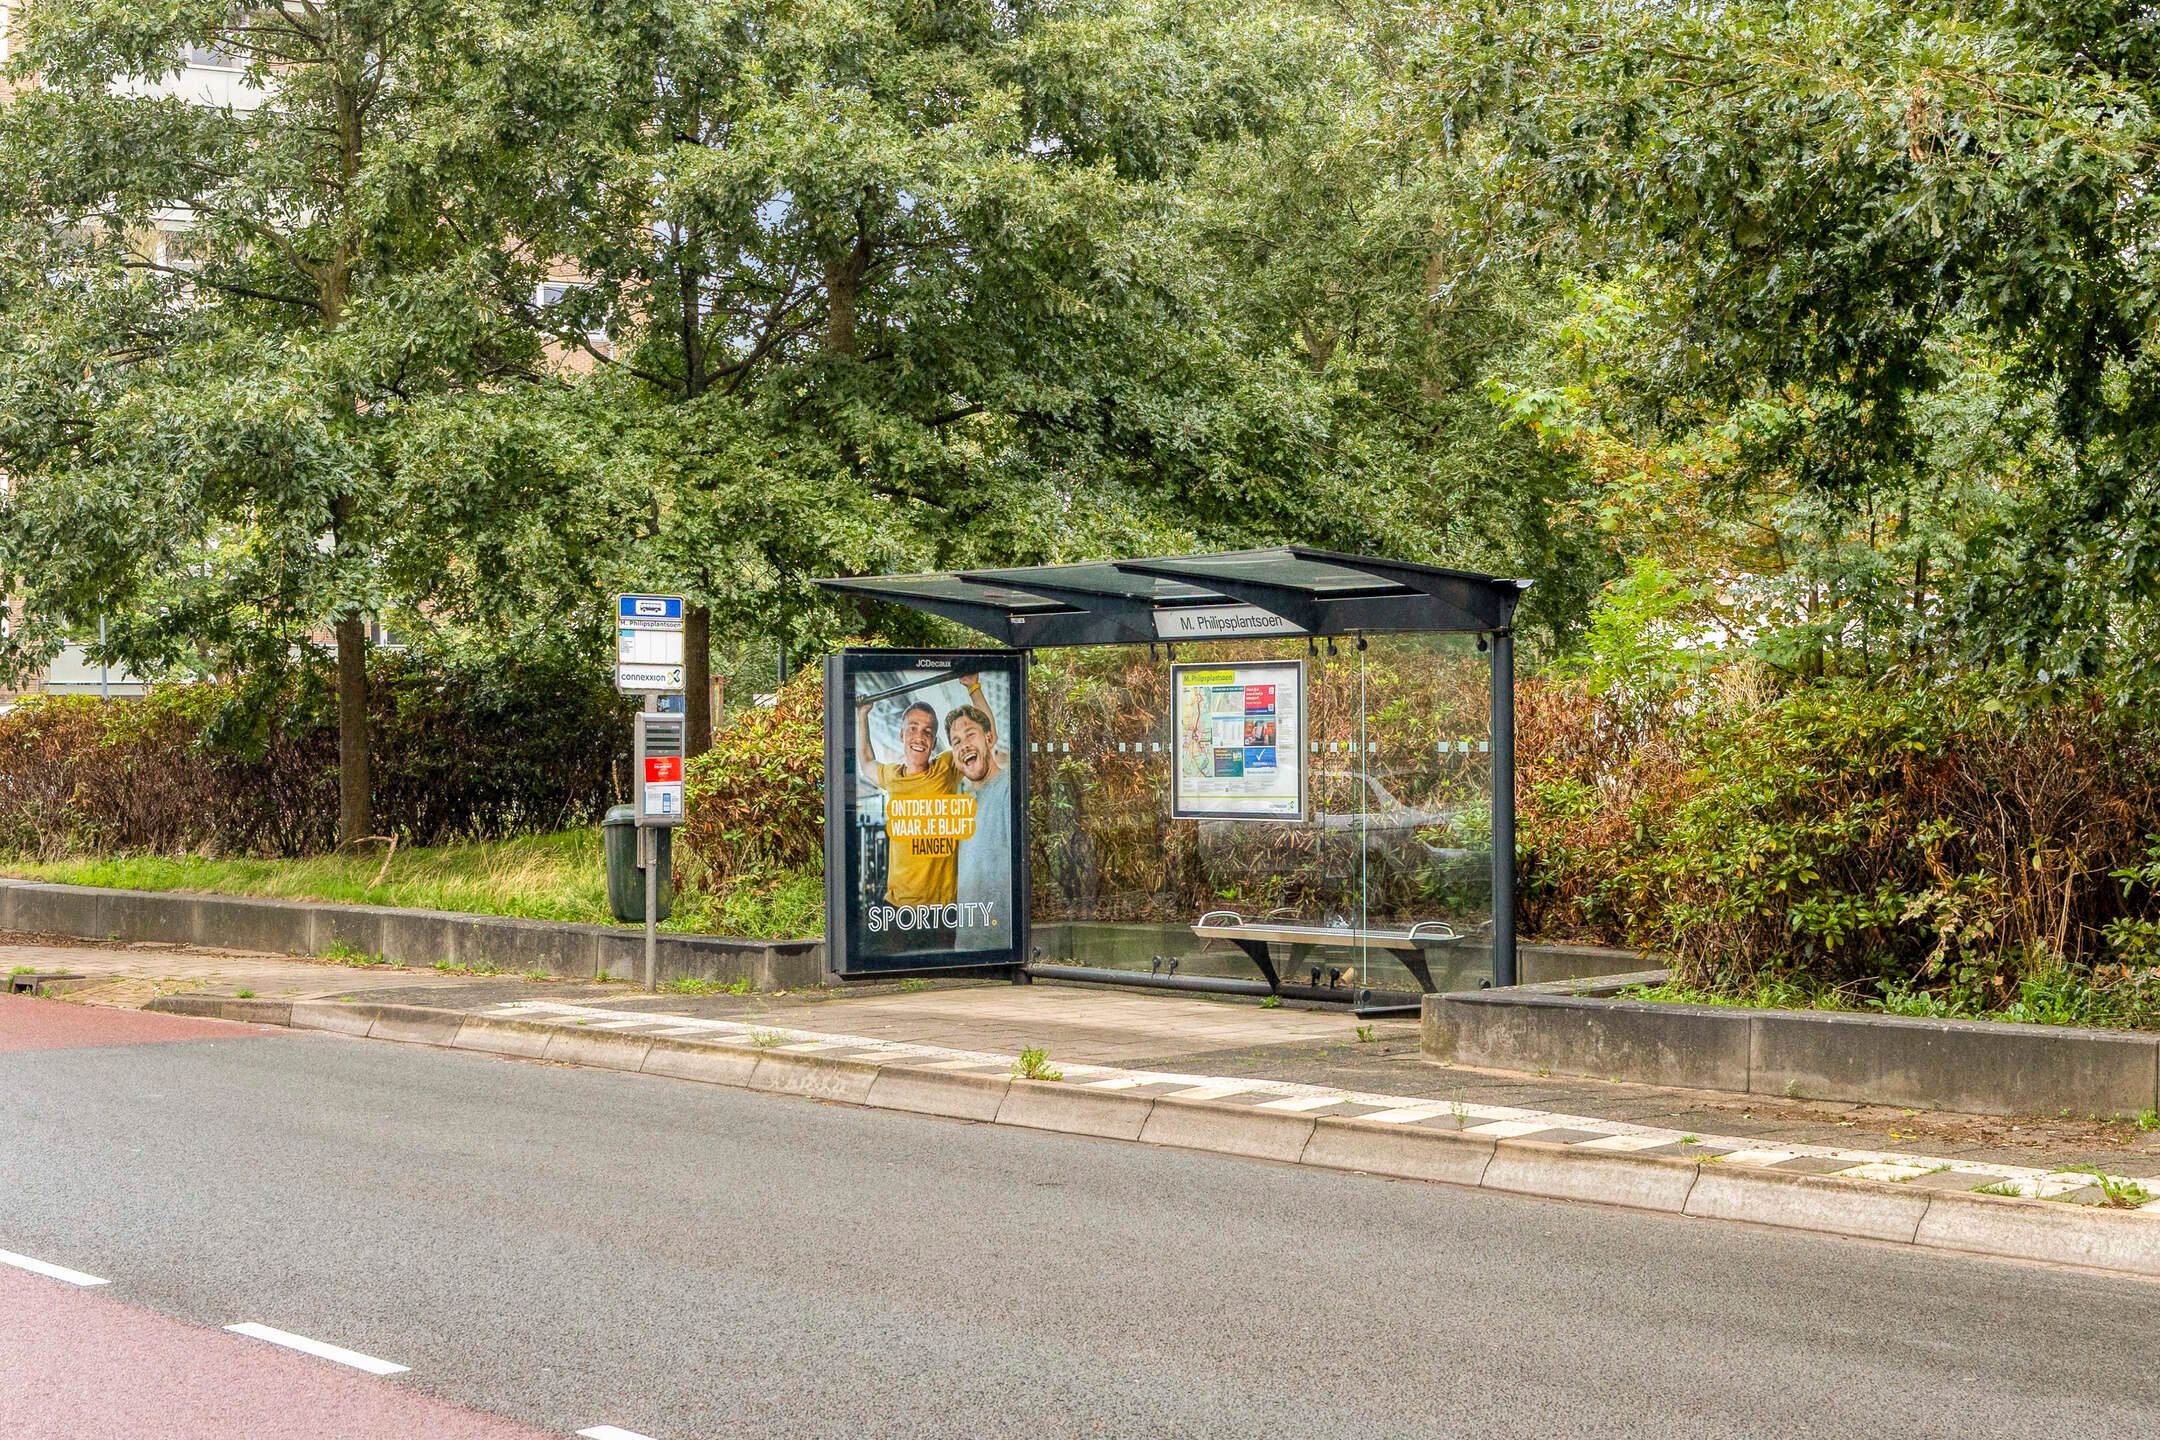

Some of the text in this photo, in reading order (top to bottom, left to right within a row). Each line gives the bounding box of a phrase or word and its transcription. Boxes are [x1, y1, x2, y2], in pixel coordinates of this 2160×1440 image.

[629, 620, 681, 628] Philipsplantsoen
[1180, 614, 1283, 632] M. Philipsplantsoen
[915, 659, 952, 668] JCDecaux
[621, 673, 666, 682] connexxion
[891, 798, 974, 817] ONTDEK DE CITY
[891, 817, 974, 837] WAAR JE BLIJFT
[912, 837, 954, 855] HANGEN
